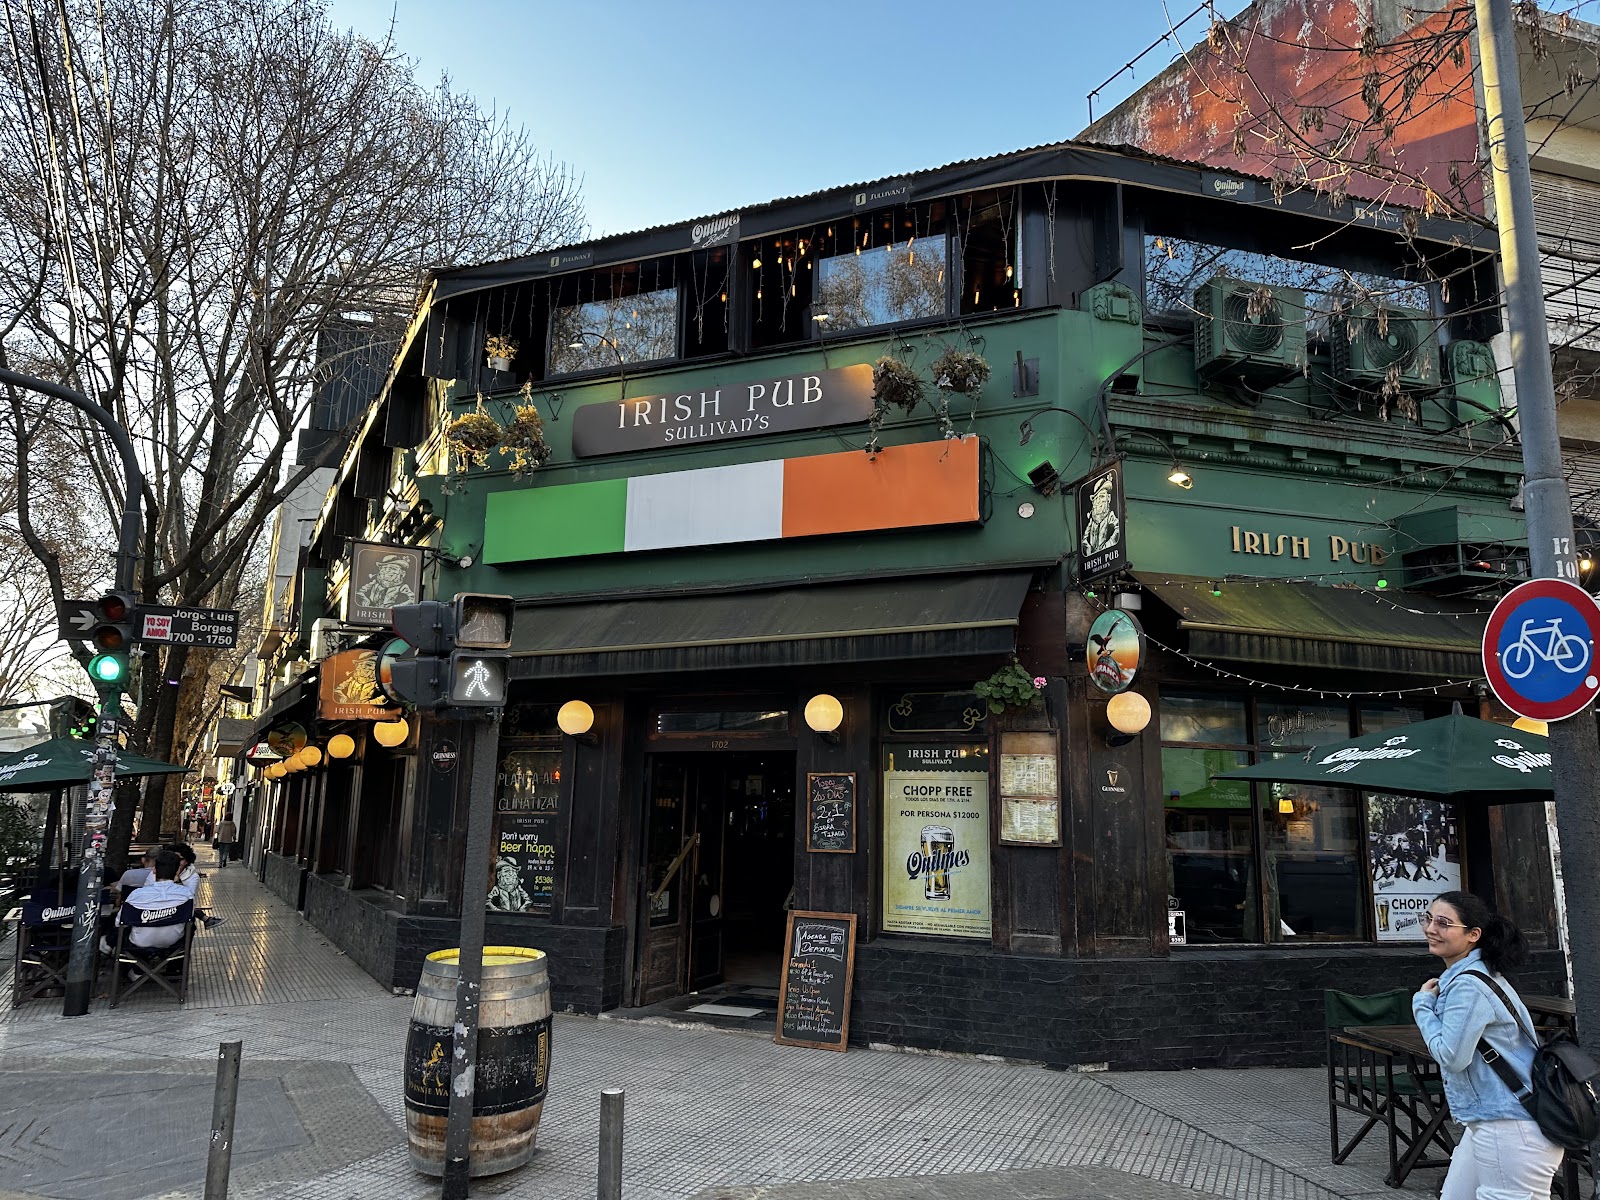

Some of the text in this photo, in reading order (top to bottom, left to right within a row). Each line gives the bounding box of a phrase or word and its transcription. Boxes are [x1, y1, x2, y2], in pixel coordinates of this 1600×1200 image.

[692, 212, 741, 244] Quilmes
[618, 375, 824, 429] IRISH PUB
[664, 413, 770, 442] SULLIVAN'S
[1231, 525, 1386, 566] IRISH PUB
[1552, 537, 1570, 555] 17
[1084, 549, 1119, 571] IRISH PUB
[172, 609, 235, 622] Jorge Luis
[356, 610, 386, 619] IRISH
[145, 616, 171, 627] YO SOY
[191, 621, 233, 634] Borges
[145, 628, 168, 638] AMOR
[169, 633, 194, 643] 1700
[206, 634, 233, 645] 1750
[367, 707, 386, 715] PUB
[711, 741, 728, 749] 1702
[433, 751, 456, 760] GUINNESS
[908, 749, 967, 758] IRISH PUB
[1316, 746, 1421, 766] Quilmes
[0, 758, 53, 774] uilmes
[1491, 750, 1552, 773] Quilm
[903, 785, 973, 797] CHOPP FREE
[1101, 785, 1126, 793] GUINNESS
[498, 795, 559, 811] CLIMATIZA
[917, 810, 951, 818] PERSONA
[953, 811, 980, 819] $12000
[501, 832, 539, 844] Don't worry
[500, 841, 522, 853] Beer
[906, 848, 970, 881] Quilmes
[1391, 898, 1429, 910] CHOPP
[41, 905, 76, 922] Quilme
[140, 906, 178, 924] Quilmes
[1395, 917, 1418, 931] Quilmes
